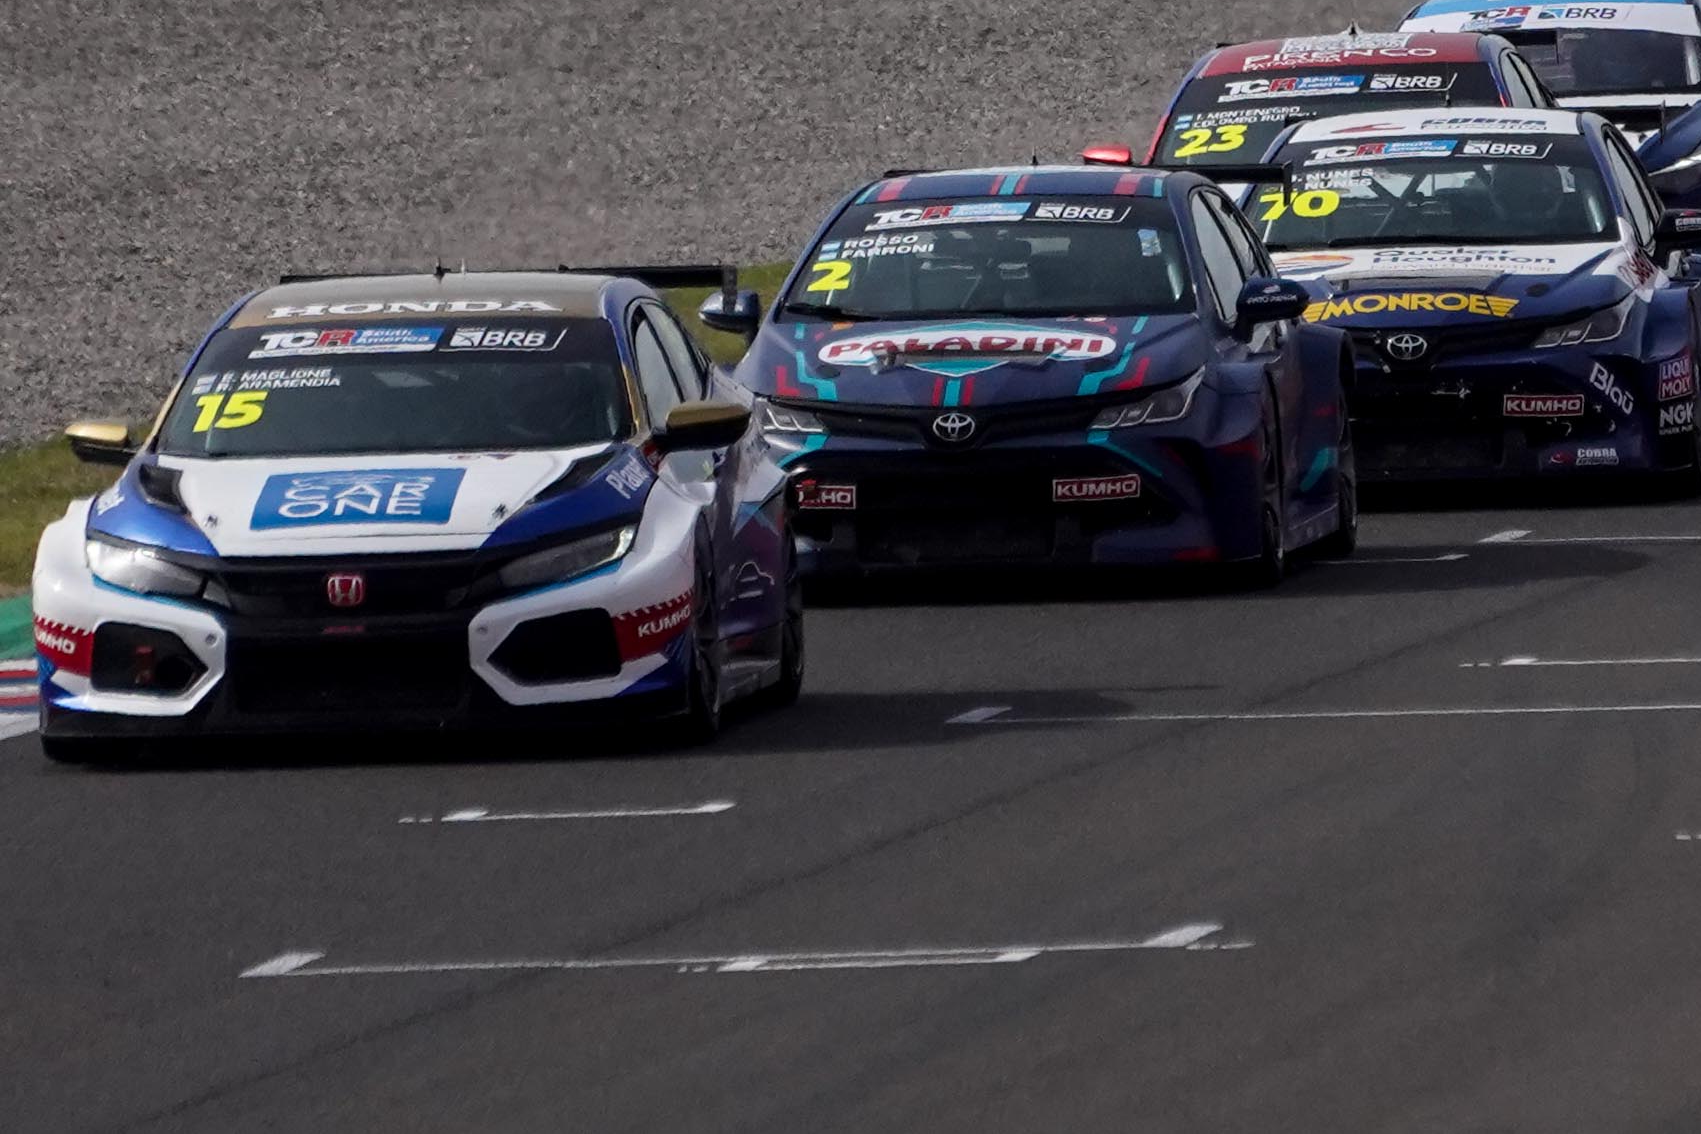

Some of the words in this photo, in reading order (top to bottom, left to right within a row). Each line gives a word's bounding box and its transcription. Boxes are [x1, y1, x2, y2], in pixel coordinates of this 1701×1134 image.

[1565, 7, 1617, 20] BRB
[1224, 77, 1297, 97] TCR
[1395, 75, 1443, 89] BRB
[1174, 125, 1248, 157] 23
[1488, 143, 1538, 156] BRB
[1310, 143, 1387, 161] TCR
[1305, 168, 1374, 181] NUNES
[1064, 206, 1116, 220] BRB
[1259, 189, 1341, 221] 70
[873, 205, 954, 225] TCR
[844, 234, 919, 249] ROSSO
[1372, 254, 1557, 264] Houghton
[1373, 248, 1518, 256] Quaker
[807, 261, 852, 292] 2
[266, 300, 564, 319] HONDA
[1320, 293, 1489, 321] MONROE
[259, 329, 356, 351] TCR
[481, 330, 547, 347] BRB
[827, 335, 1104, 359] PALADINI
[238, 377, 342, 391] ARAMENDIA
[240, 368, 333, 382] MAGLIONE
[1661, 376, 1692, 398] MOLY
[192, 391, 269, 433] 15
[1506, 399, 1581, 412] KUMHO
[1659, 402, 1694, 428] NGK
[1577, 448, 1617, 458] COBRA
[285, 482, 430, 501] CAR
[1056, 479, 1138, 497] KUMHO
[278, 497, 422, 518] ONE
[637, 605, 691, 638] KUMHO
[34, 626, 77, 654] UMHO
